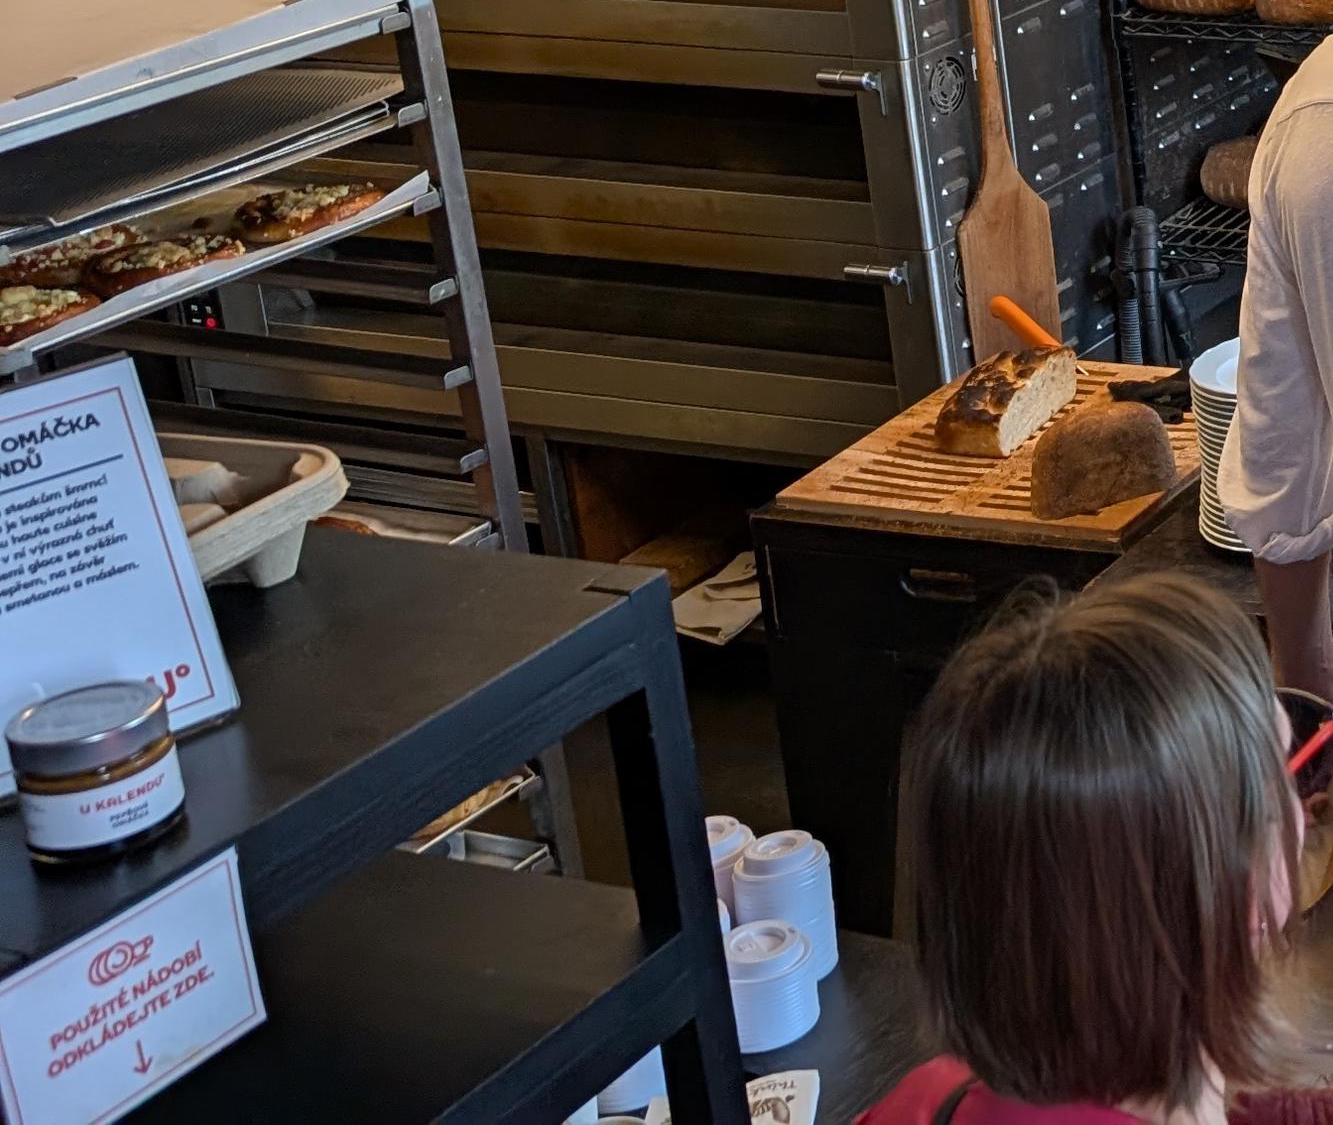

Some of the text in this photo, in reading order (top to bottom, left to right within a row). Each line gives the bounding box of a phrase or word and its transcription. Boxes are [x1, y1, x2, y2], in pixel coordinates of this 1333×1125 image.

[1, 413, 101, 453] OMÁČKA
[47, 964, 215, 1079] ODKLÁDEJTE ZDE.
[50, 938, 203, 1051] POUŽITÉ NÁDOBÍ
